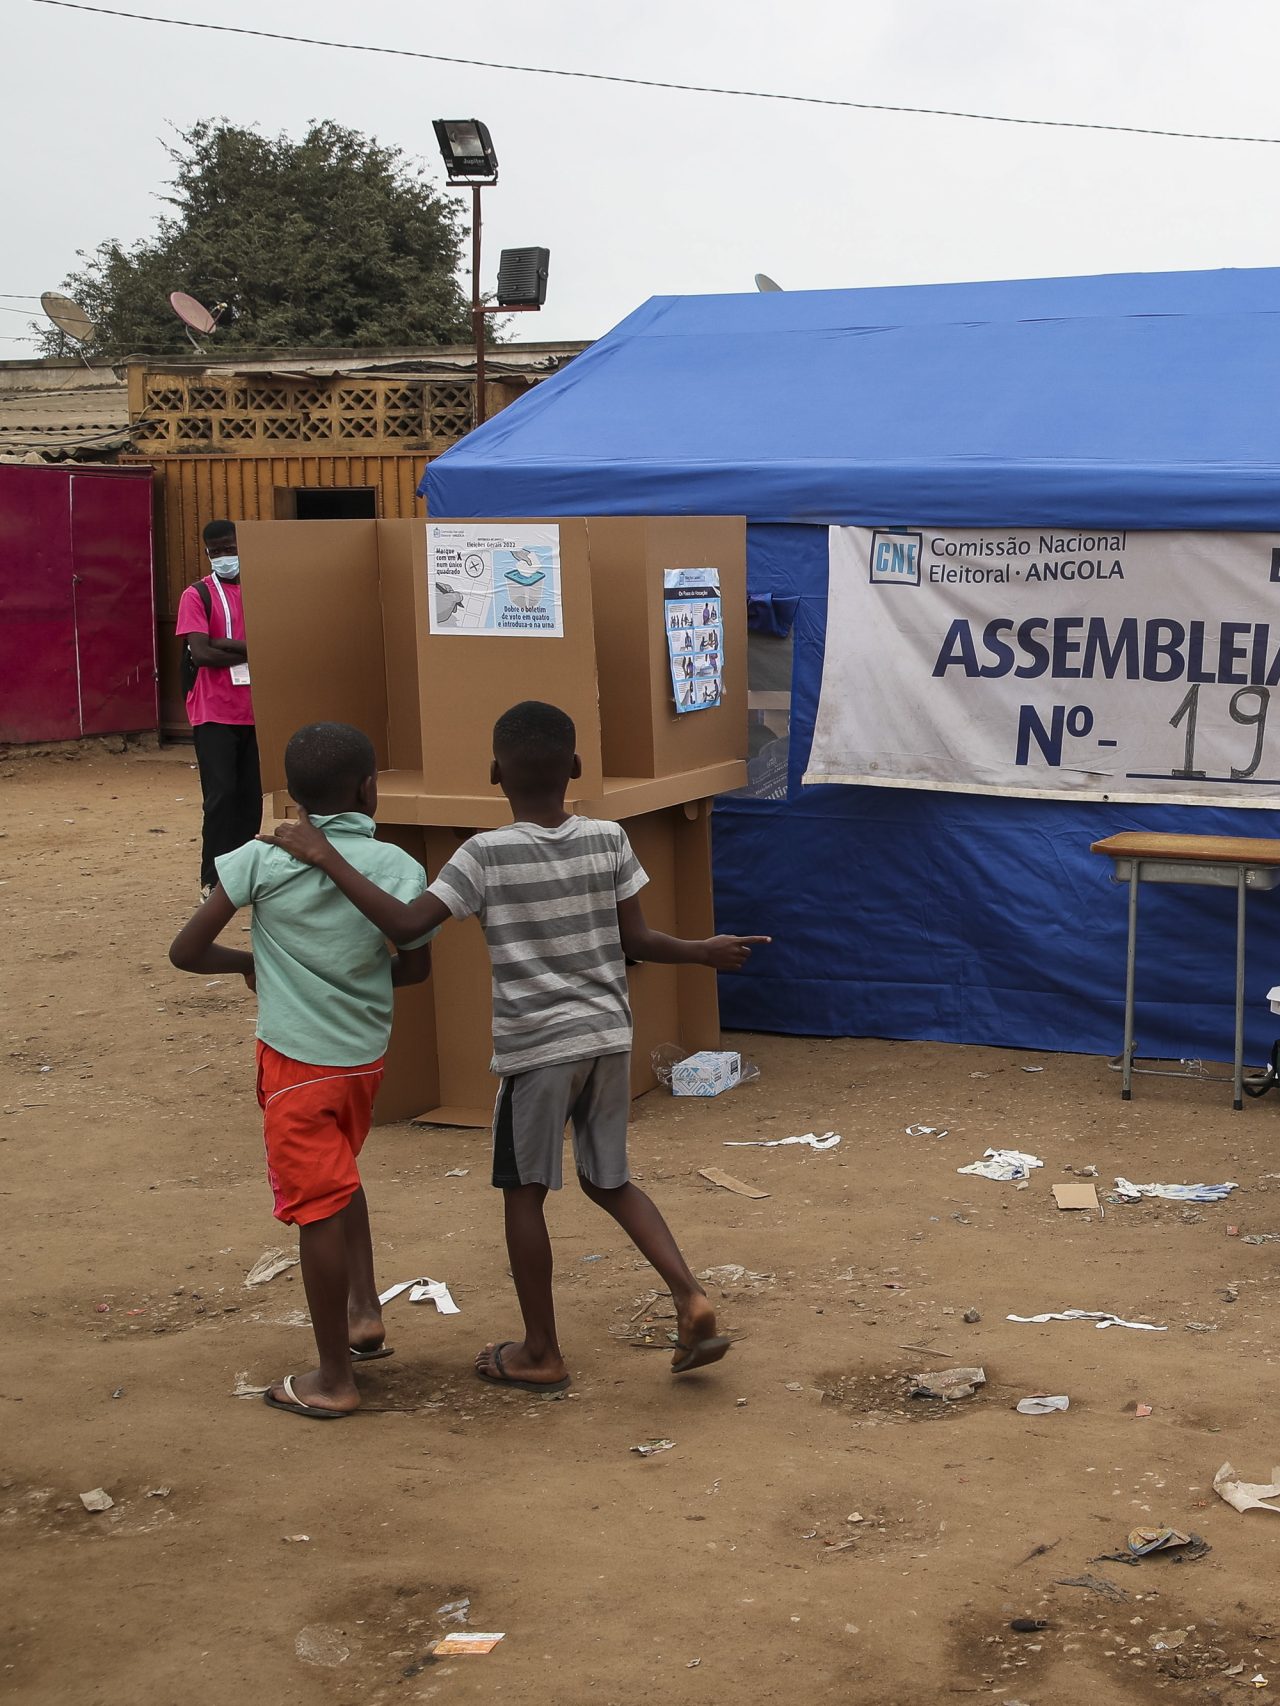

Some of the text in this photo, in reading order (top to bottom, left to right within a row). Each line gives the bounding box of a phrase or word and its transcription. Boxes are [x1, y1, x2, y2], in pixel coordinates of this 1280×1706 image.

[931, 531, 1126, 557] Comissão Nacional
[875, 542, 917, 575] CNE
[929, 560, 1125, 583] Eleitoral ANGOLA
